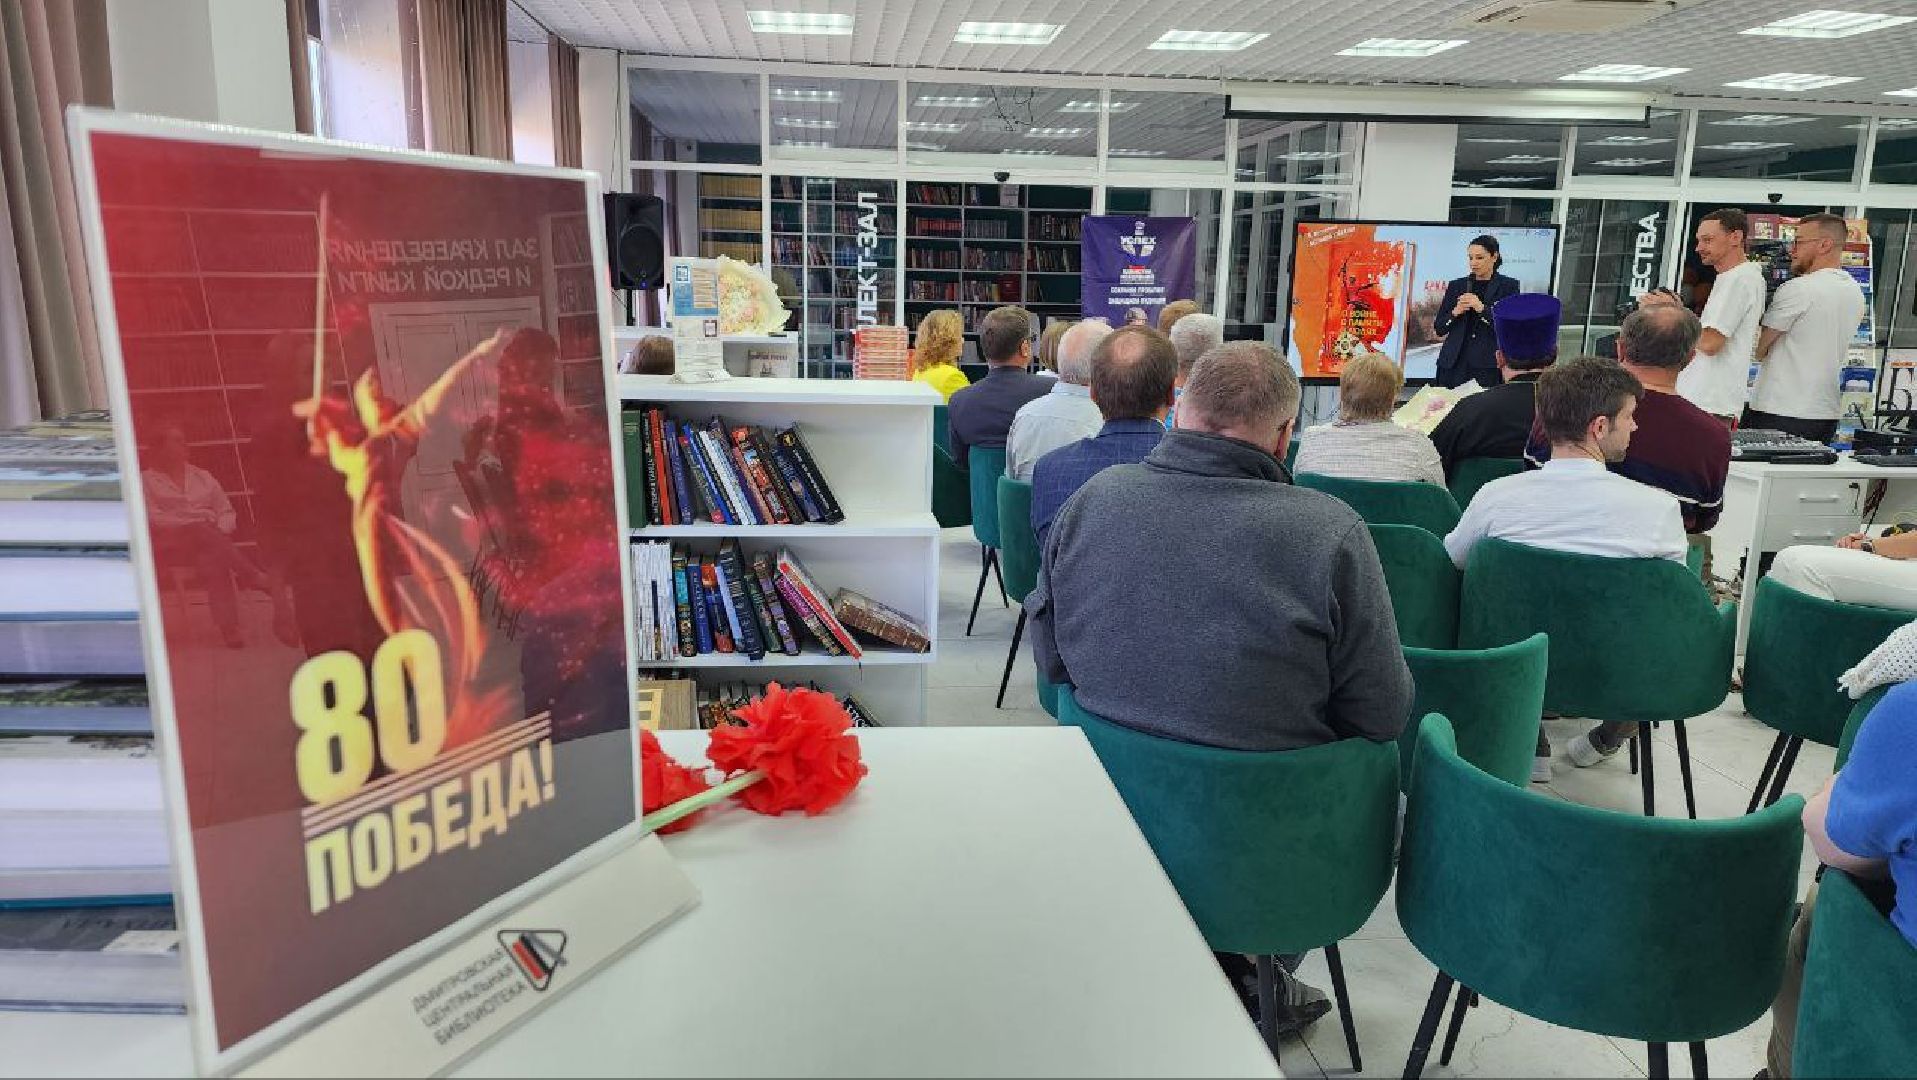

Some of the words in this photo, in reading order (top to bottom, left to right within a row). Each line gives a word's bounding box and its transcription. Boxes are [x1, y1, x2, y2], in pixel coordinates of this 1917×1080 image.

[1120, 235, 1157, 245] УСПЕХ
[289, 627, 448, 807] 80
[304, 737, 556, 916] ПОБЕДА!
[412, 948, 504, 1013] ДМИТРОВСКАЯ
[421, 962, 513, 1028] ЦЕНТРАЛЬНАЯ
[434, 980, 526, 1045] БИБЛИОТЕКА
